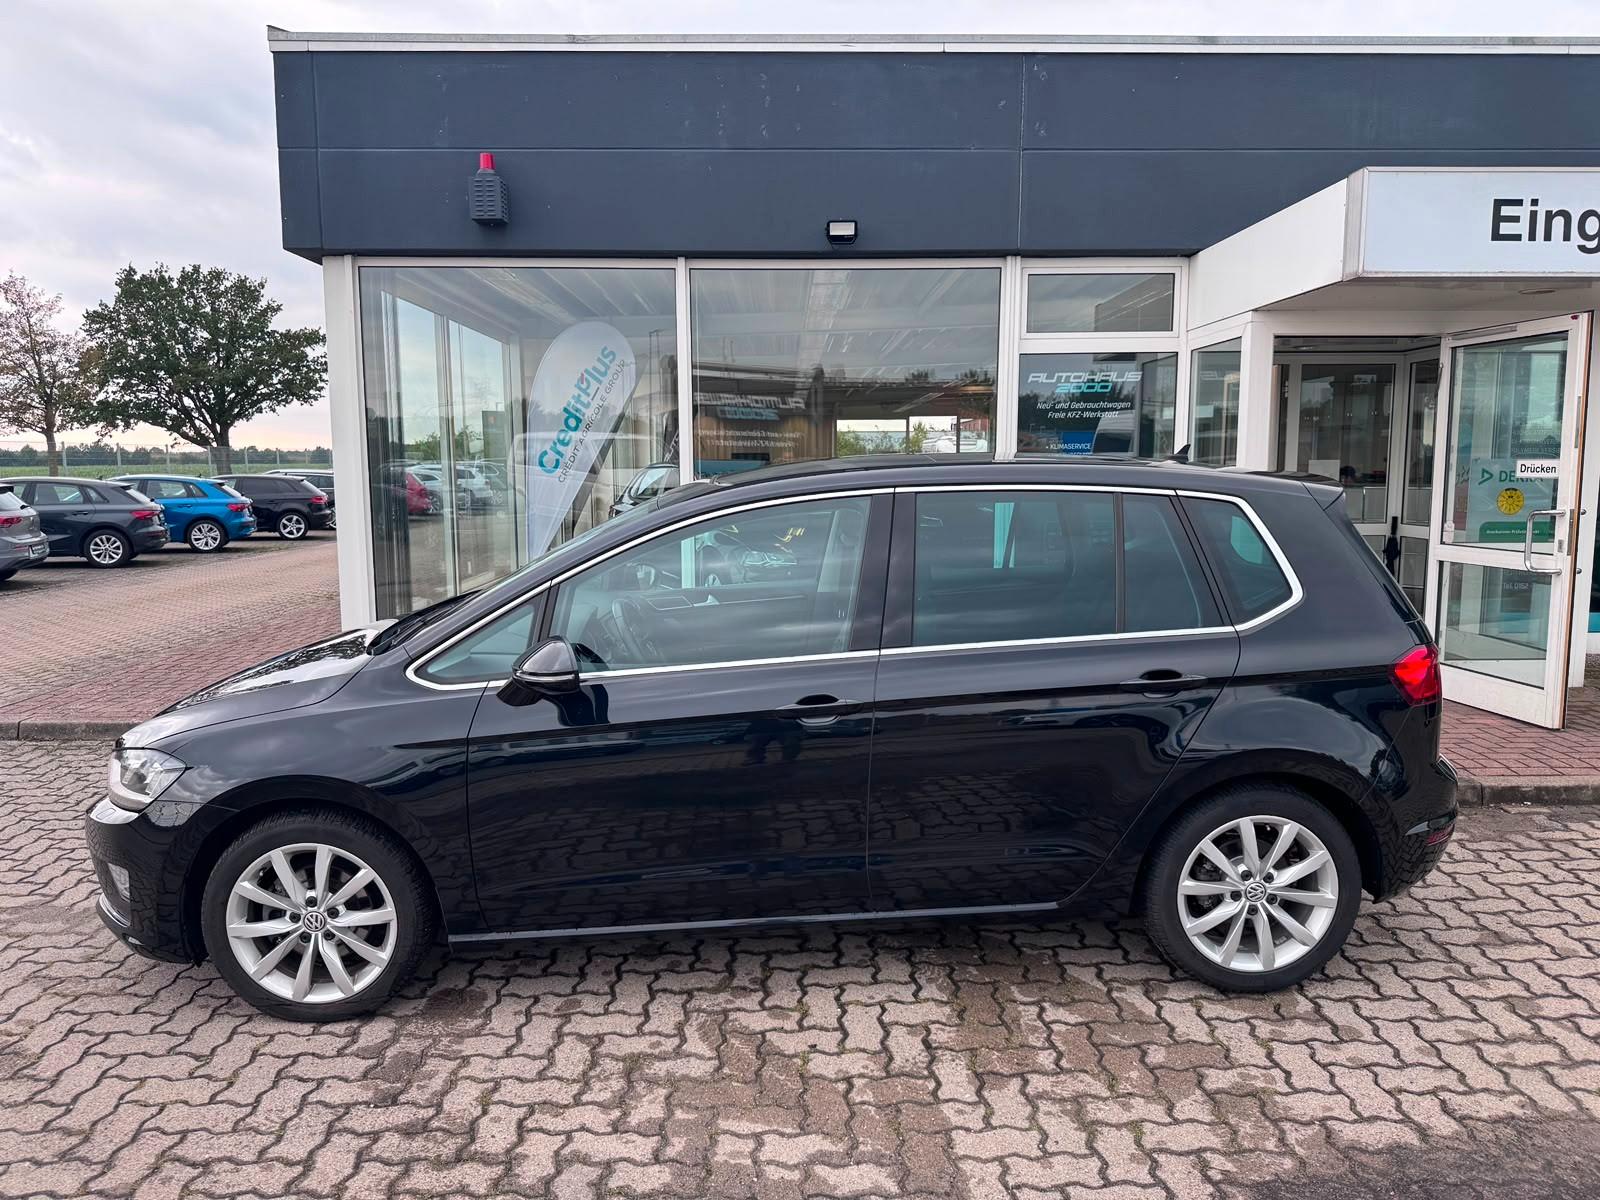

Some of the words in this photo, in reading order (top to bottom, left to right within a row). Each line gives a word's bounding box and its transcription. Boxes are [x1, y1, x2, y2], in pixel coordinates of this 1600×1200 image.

[1491, 198, 1600, 254] Eing
[1028, 371, 1143, 383] AUTOHAUS
[1055, 383, 1112, 393] 2000
[538, 345, 617, 475] CreditPlus
[1055, 401, 1069, 409] und
[1071, 401, 1131, 410] Gebrauchtwagen
[1048, 411, 1065, 419] Freie
[1520, 463, 1556, 473] Drücken
